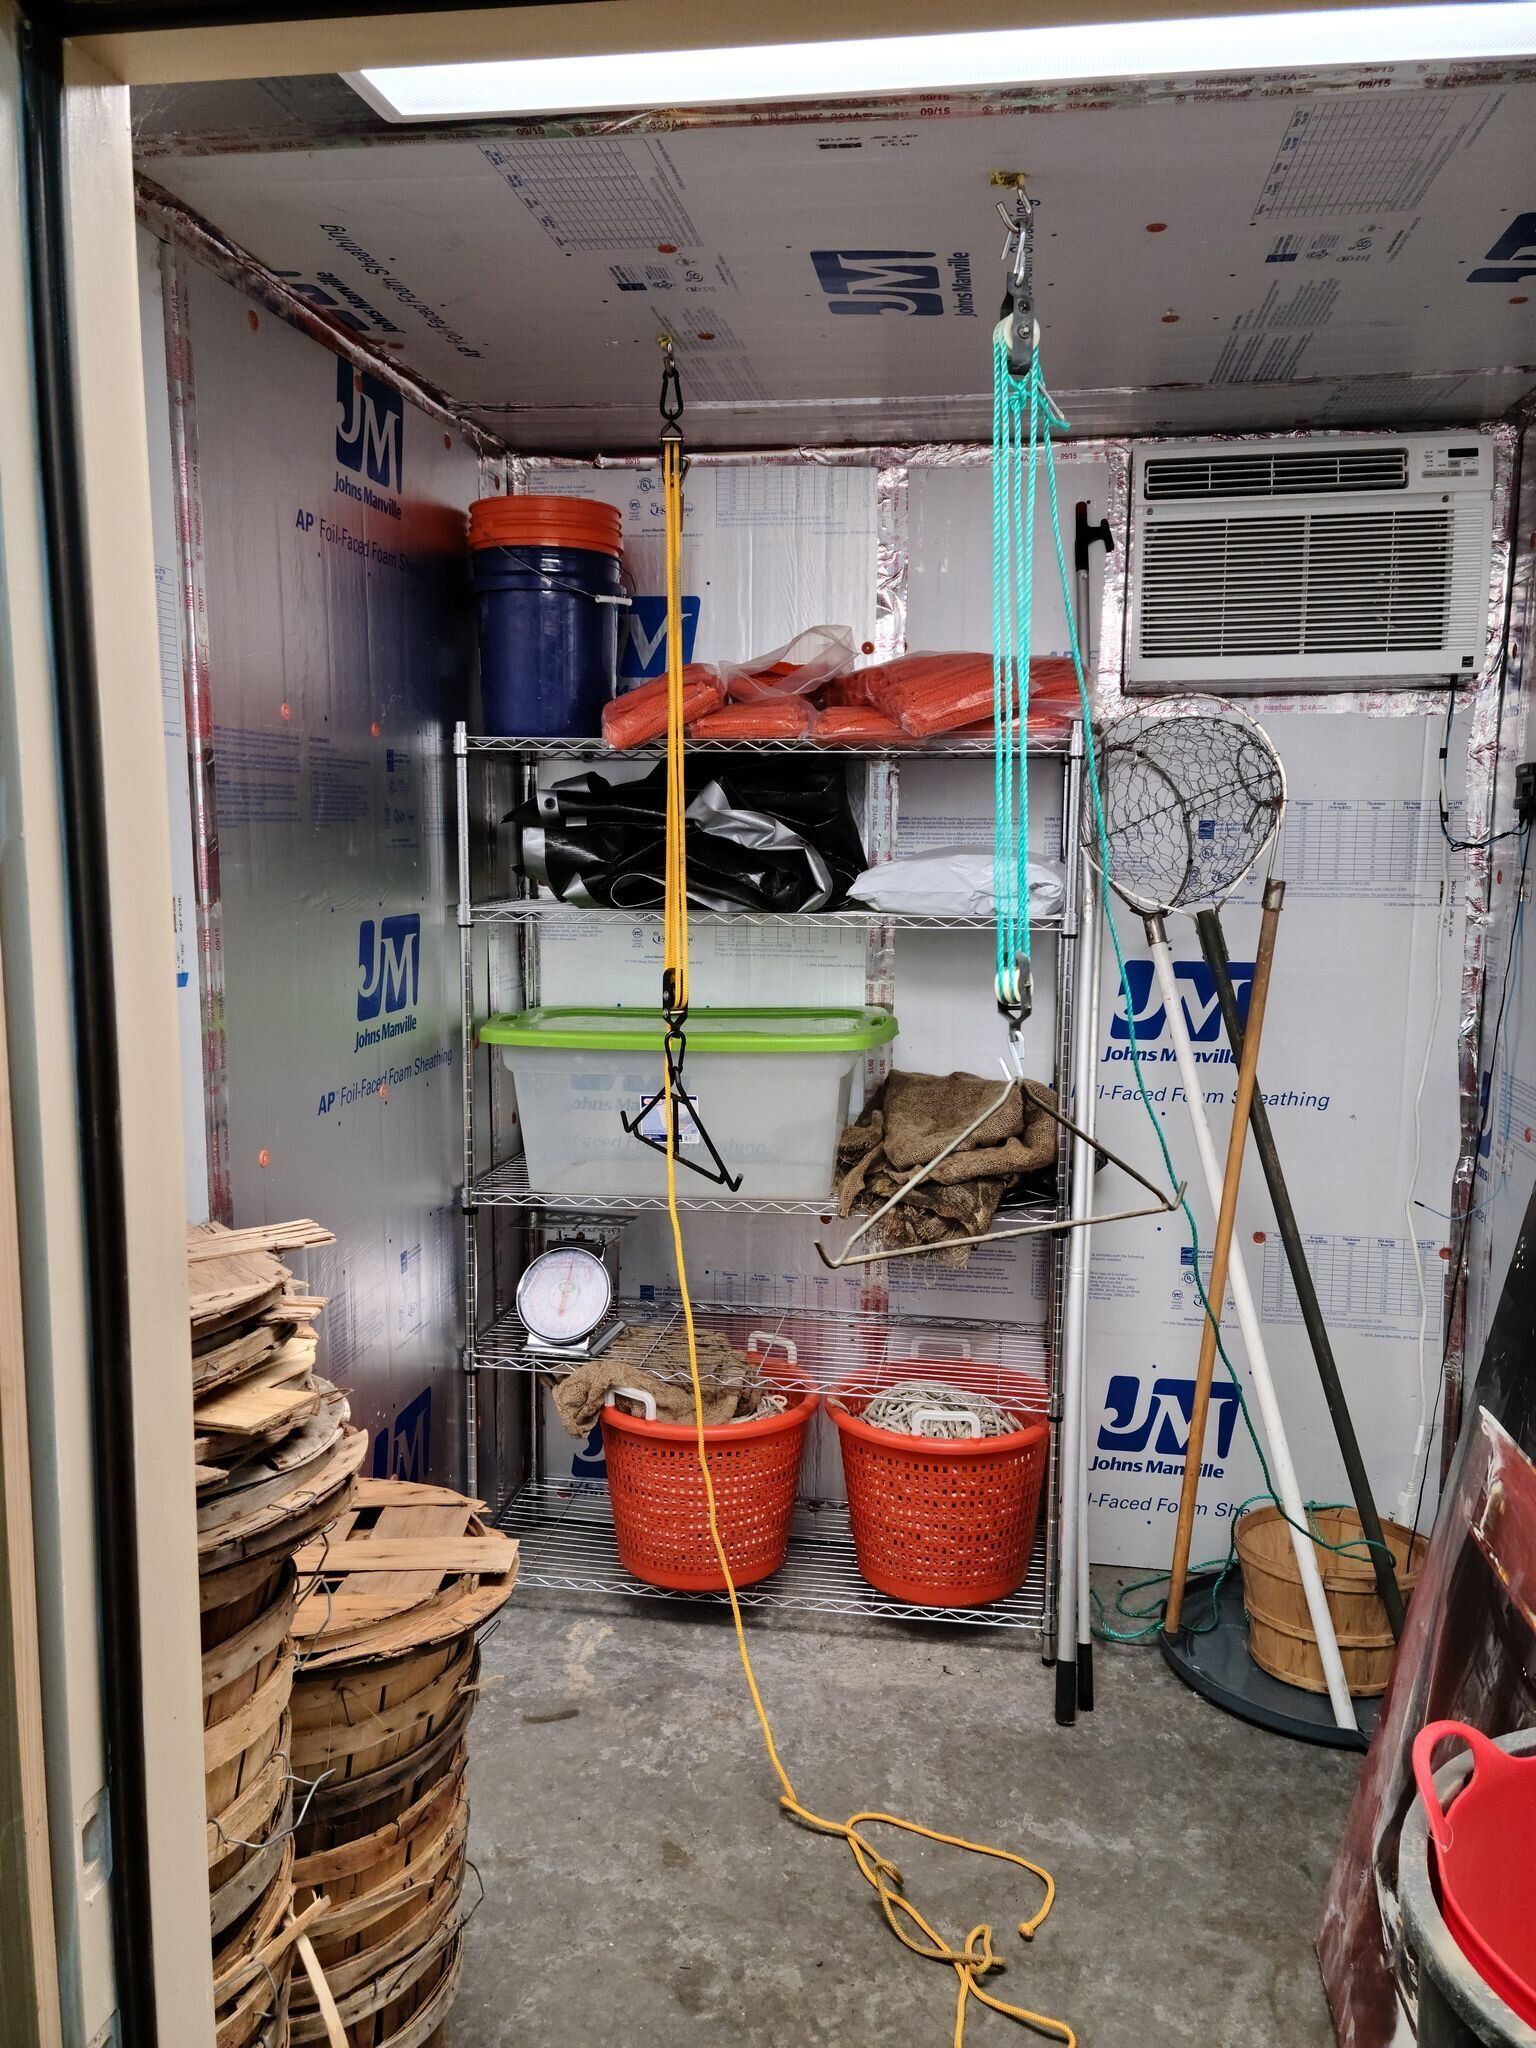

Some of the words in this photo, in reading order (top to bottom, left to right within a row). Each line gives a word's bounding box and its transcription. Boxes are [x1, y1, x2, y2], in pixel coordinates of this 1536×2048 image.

[1358, 79, 1392, 90] 09/15
[920, 107, 952, 117] 09/15
[319, 224, 390, 276] Sheathing
[316, 271, 370, 310] Manville
[810, 250, 945, 315] JM
[947, 251, 971, 293] Manville
[382, 276, 423, 308] Foam
[953, 292, 978, 317] Johns
[364, 306, 407, 334] Johns
[457, 346, 486, 359] AP
[336, 355, 405, 495] JM
[1060, 452, 1078, 460] 09/15
[333, 471, 363, 502] Johns
[363, 486, 403, 521] Manville
[295, 508, 315, 533] AP
[319, 518, 370, 557] Foil-Faced
[371, 541, 398, 568] Foam
[357, 912, 421, 1022] JM
[354, 1028, 382, 1053] Johns
[381, 1014, 418, 1040] Manville
[1101, 1046, 1158, 1063] Johns
[318, 1091, 336, 1117] AP
[340, 1070, 388, 1107] Foil-Faced
[388, 1060, 413, 1086] Foam
[414, 1049, 453, 1076] Sheathing
[1097, 1375, 1243, 1460] JM
[1088, 1455, 1143, 1473] Johns
[1145, 1460, 1225, 1480] Manille
[1156, 1497, 1208, 1516] Fom
